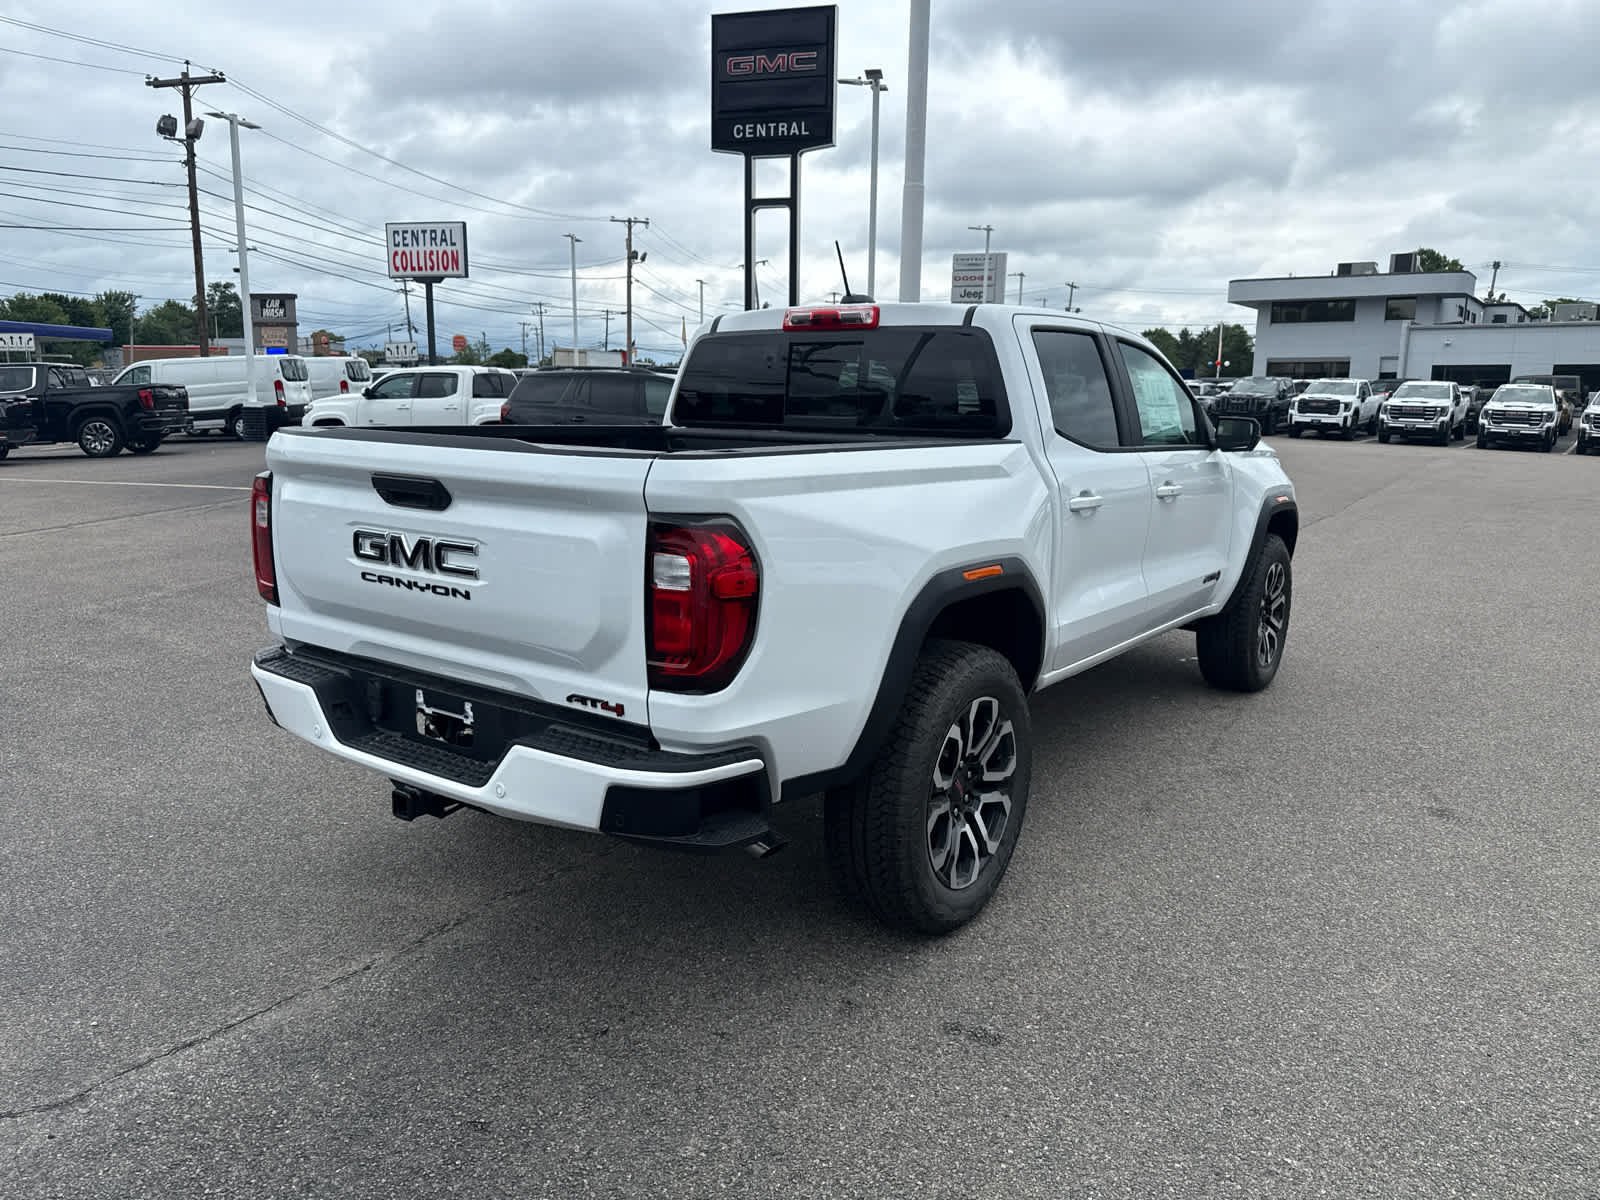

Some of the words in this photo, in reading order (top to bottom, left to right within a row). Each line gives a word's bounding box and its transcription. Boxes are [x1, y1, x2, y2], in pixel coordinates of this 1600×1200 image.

[726, 51, 817, 75] GMC
[733, 121, 810, 138] CENTRAL
[392, 229, 457, 247] CENTRAL
[392, 249, 459, 272] COLLISION
[265, 298, 281, 308] CAR
[959, 288, 985, 300] Jeep
[262, 307, 285, 318] WASH
[352, 527, 481, 581] GMC
[360, 571, 472, 601] CANYON
[566, 693, 625, 718] AT4
